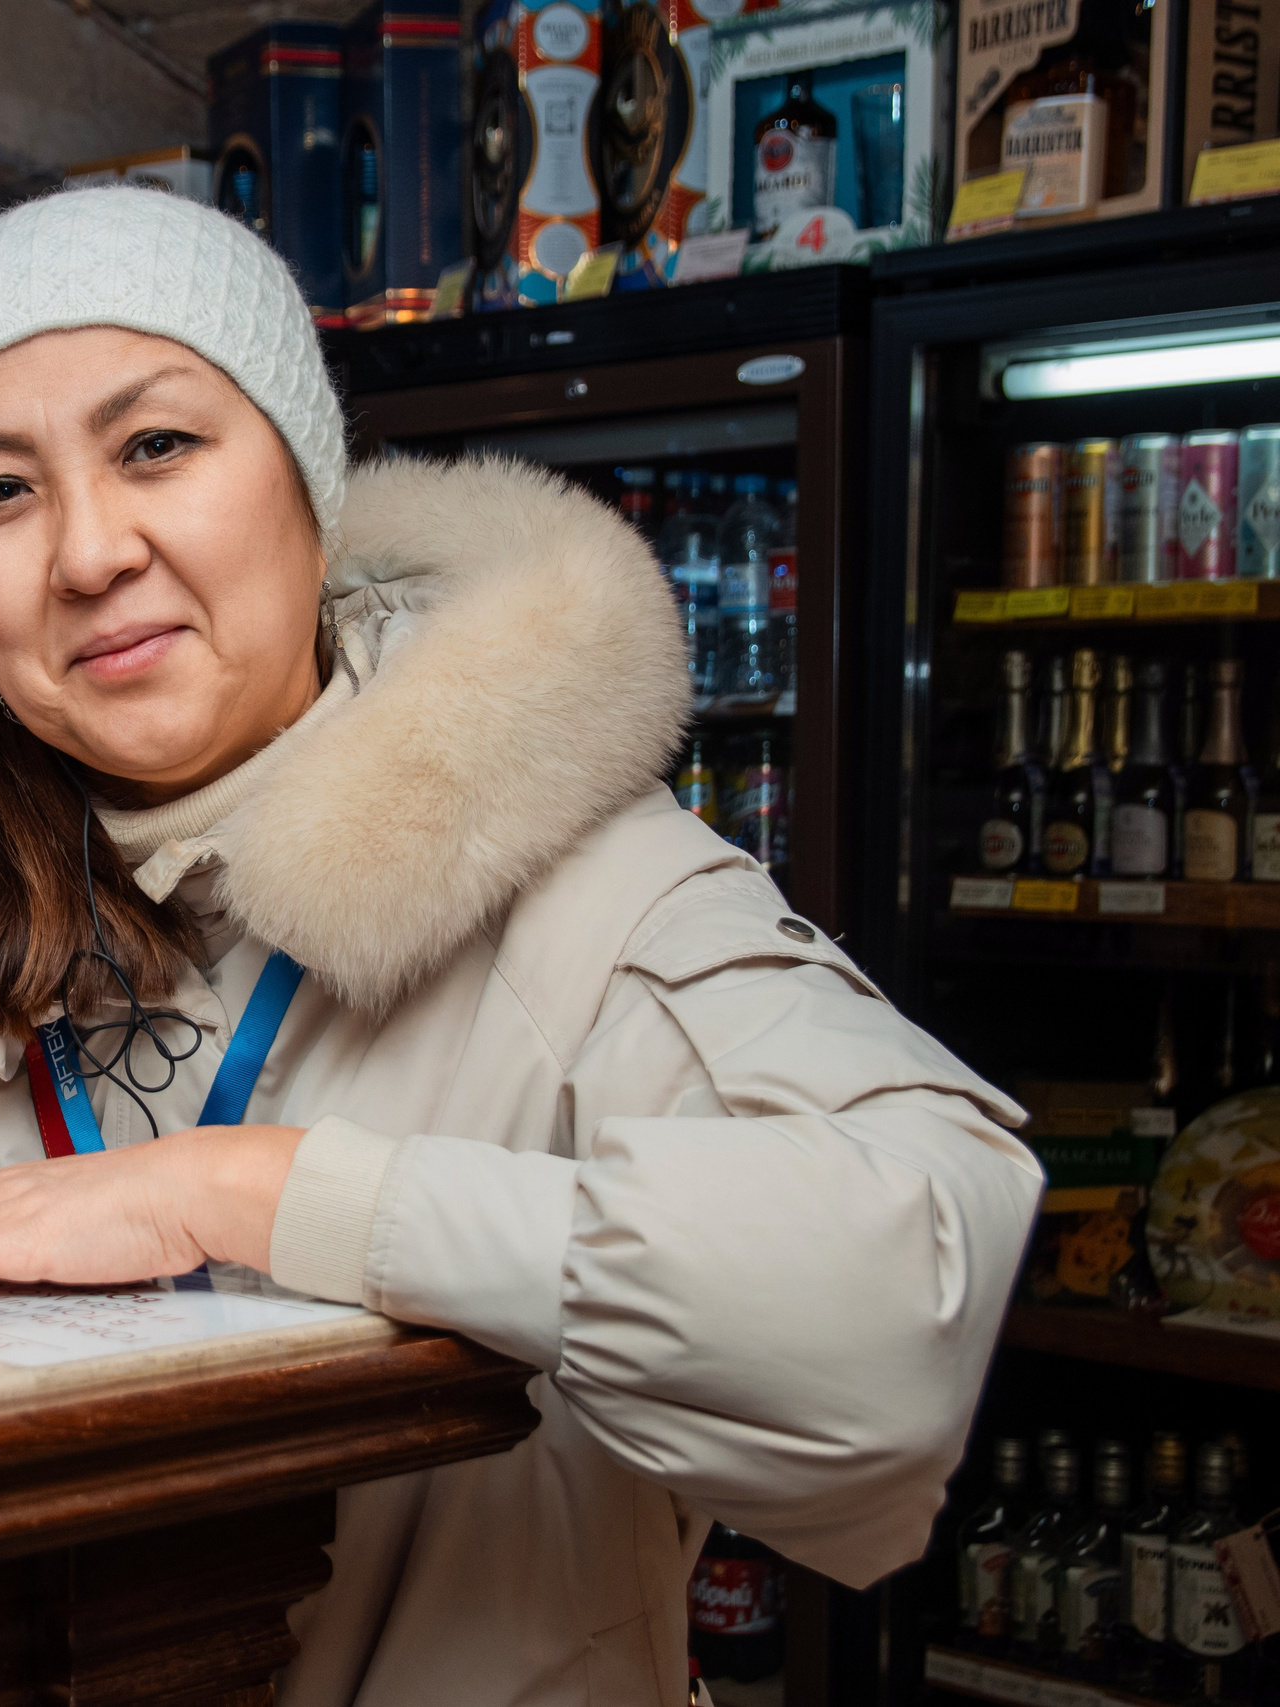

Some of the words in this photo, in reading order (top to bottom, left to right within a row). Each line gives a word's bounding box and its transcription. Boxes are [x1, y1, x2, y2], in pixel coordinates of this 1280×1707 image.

[969, 0, 1070, 53] BARRISTER
[1005, 129, 1083, 157] BARRISTER
[795, 215, 827, 253] 4
